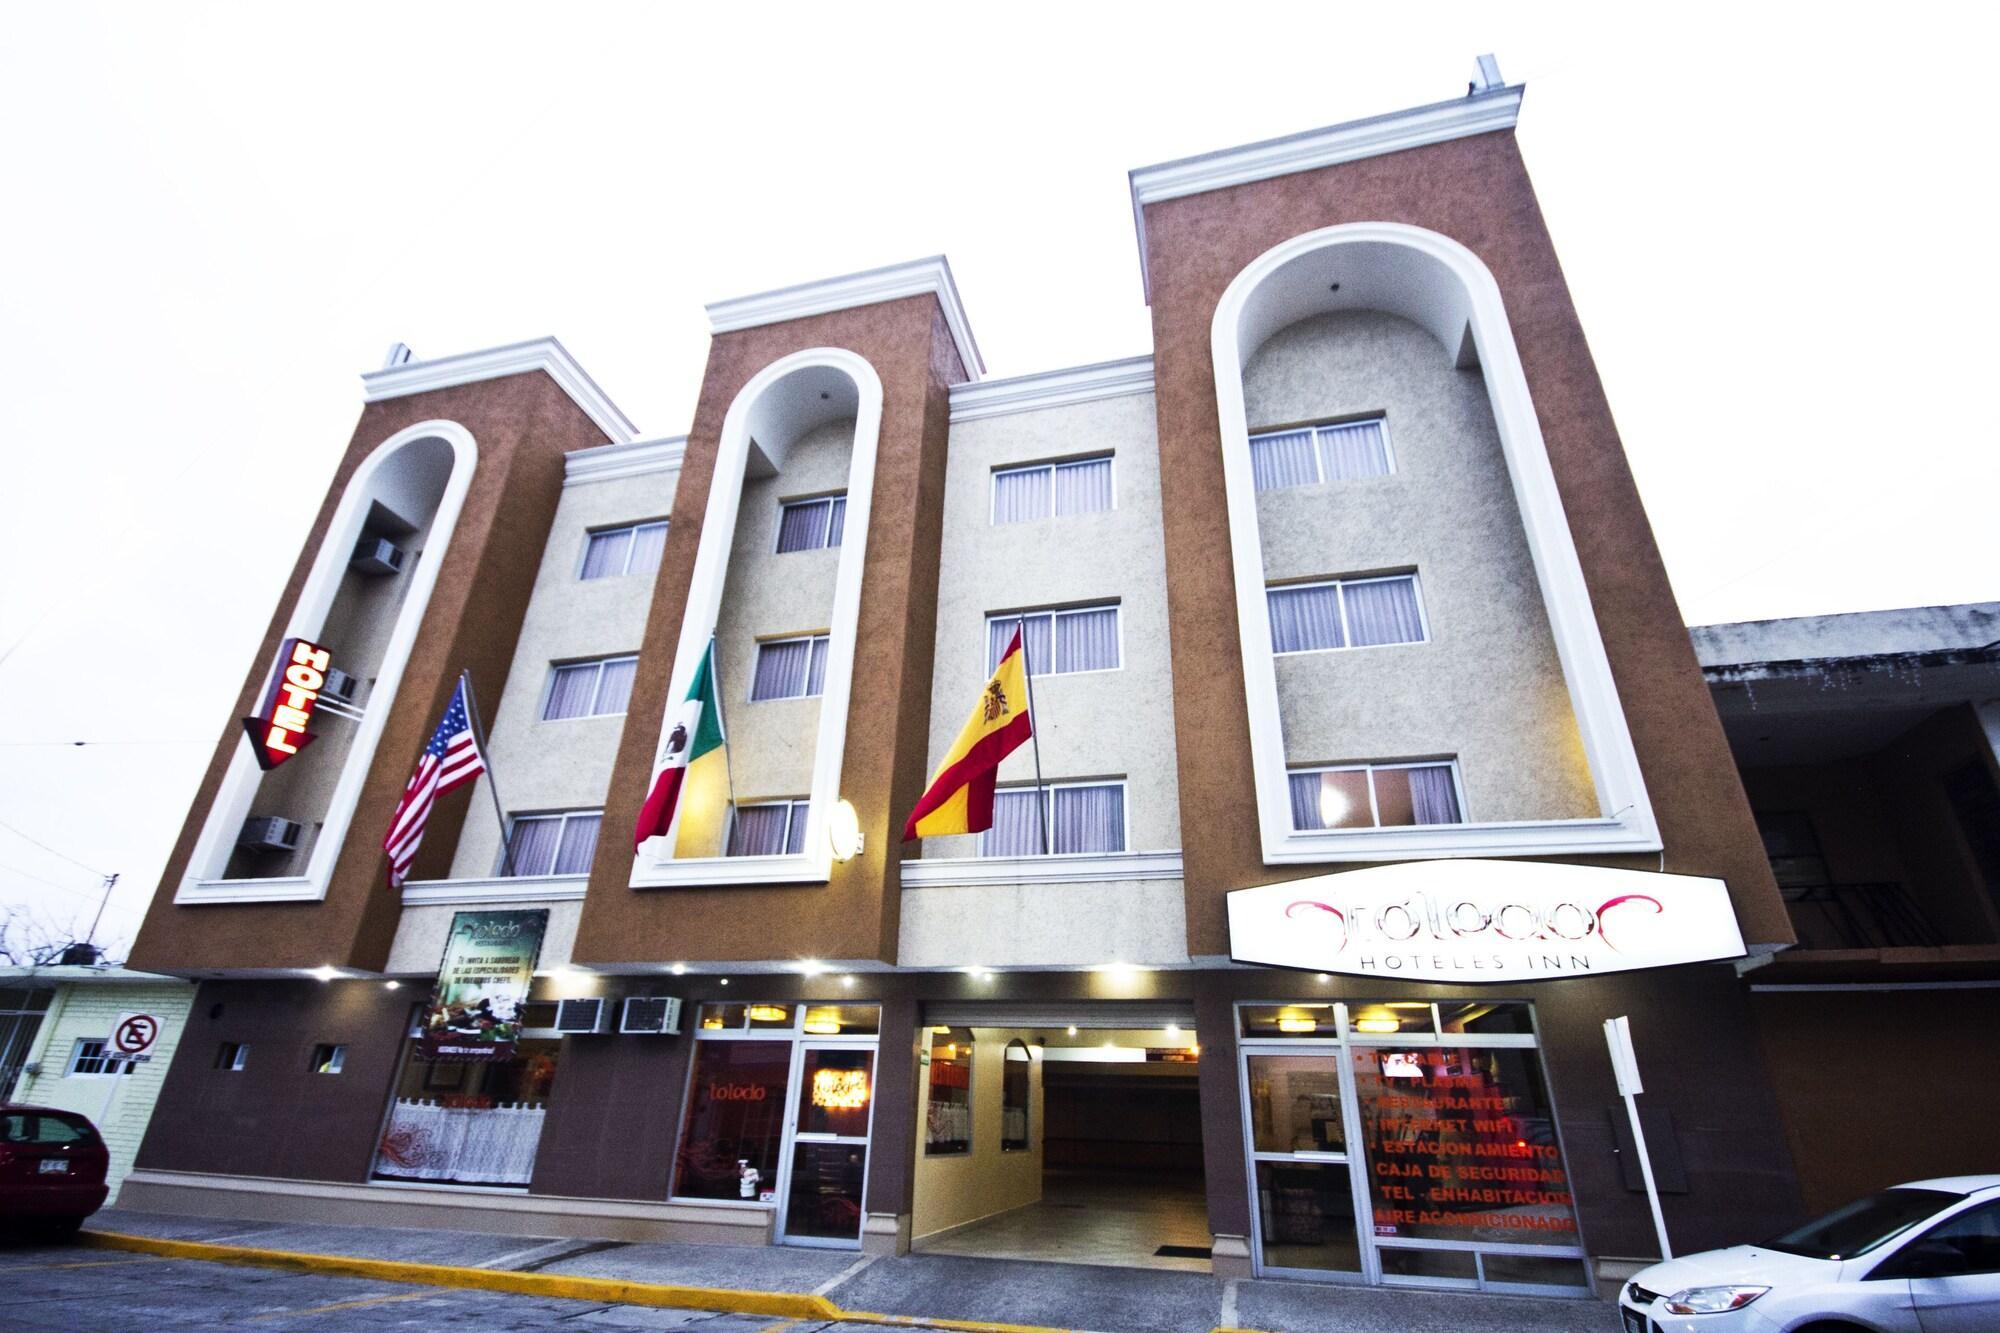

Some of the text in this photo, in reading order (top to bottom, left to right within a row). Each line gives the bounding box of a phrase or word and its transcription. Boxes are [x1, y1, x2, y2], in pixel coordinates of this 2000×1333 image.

[265, 642, 330, 755] HOTEL
[1361, 955, 1590, 970] HOTELES INN
[1376, 1162, 1565, 1183] CAJA DE SEGURIDAD
